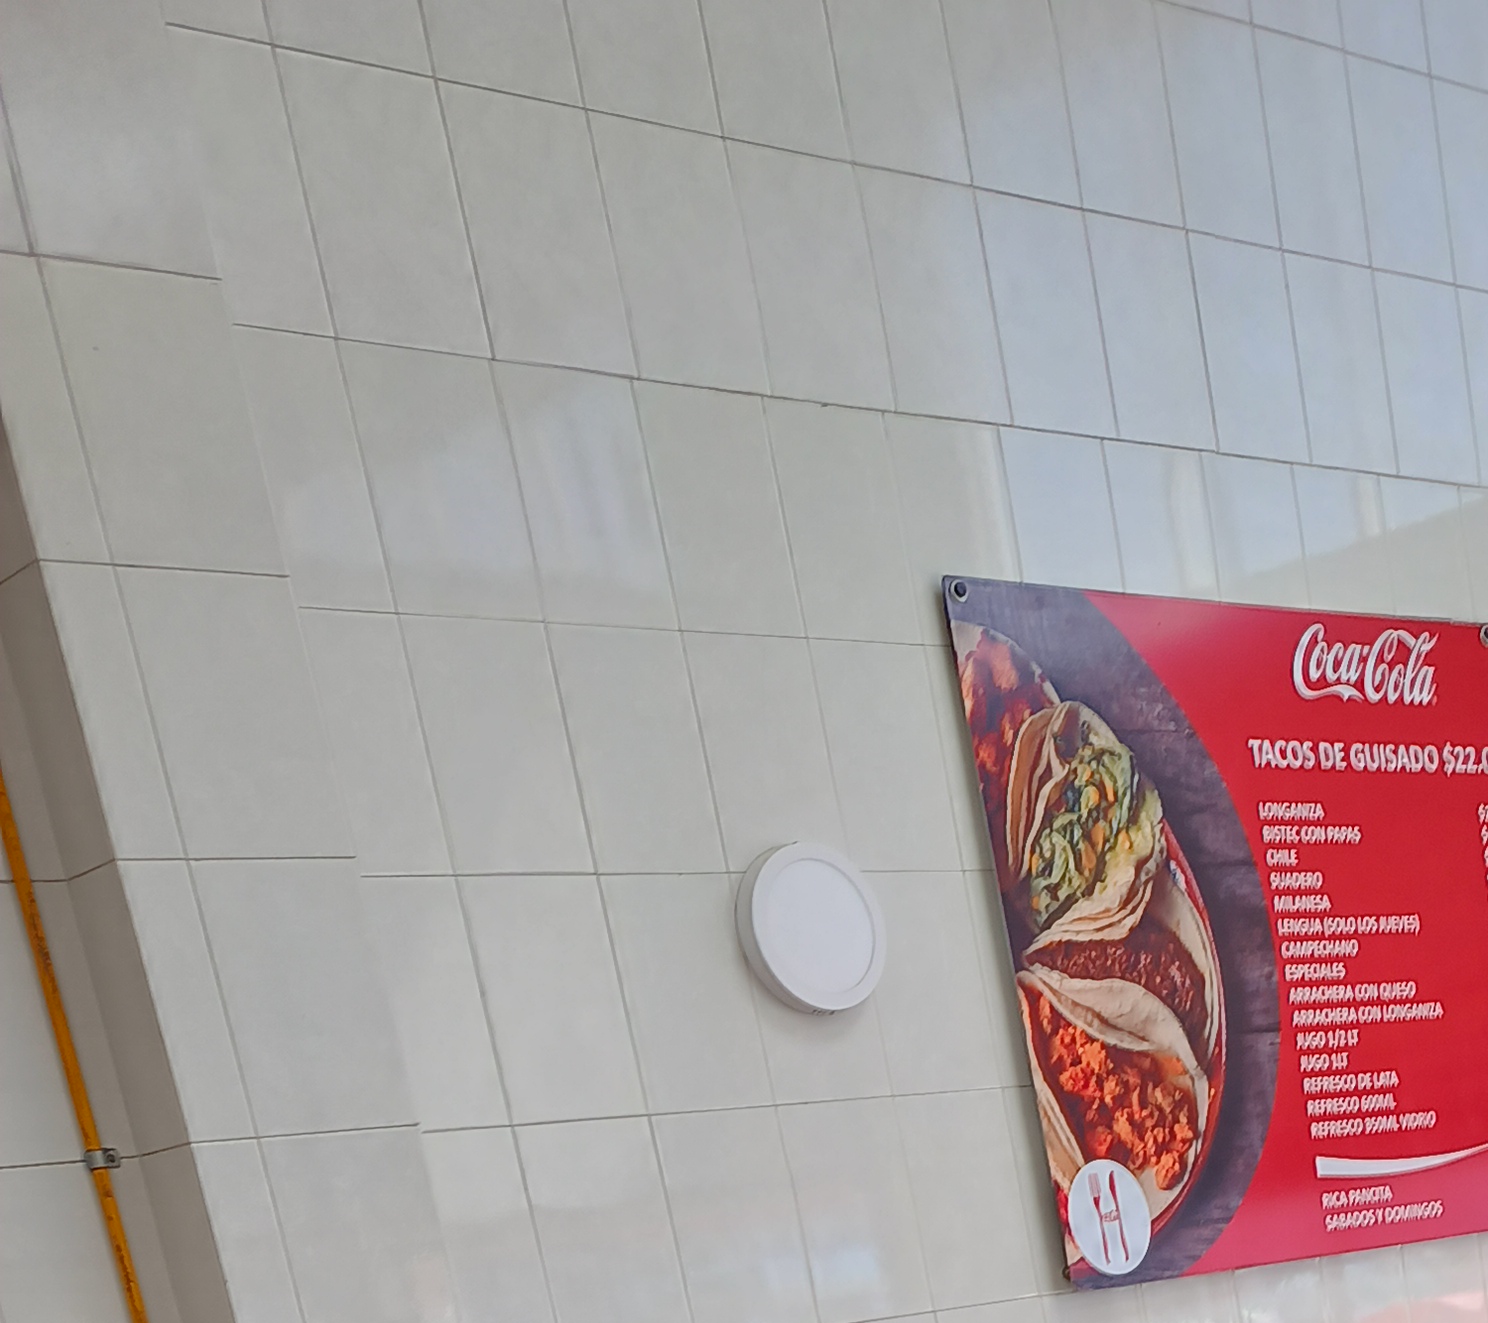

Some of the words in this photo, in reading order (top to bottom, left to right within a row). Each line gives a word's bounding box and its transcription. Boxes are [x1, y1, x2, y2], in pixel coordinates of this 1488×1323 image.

[1293, 622, 1438, 706] Coca-Cola
[1248, 739, 1315, 769] TACOS
[1319, 742, 1347, 771] DE
[1350, 743, 1439, 773] GUISADO
[1258, 802, 1325, 820] LONGANIZA
[1262, 825, 1300, 843] BISTEC
[1301, 826, 1326, 843] CON
[1327, 826, 1361, 844] PAPAS
[1266, 849, 1298, 866] CHILE
[1270, 872, 1323, 889] SUADERO
[1274, 895, 1331, 912] MILANESA
[1277, 918, 1323, 936] LENGUA
[1324, 916, 1356, 937] (SOLO
[1357, 916, 1378, 934] LOS
[1379, 914, 1420, 936] JUEVES)
[1281, 939, 1359, 958] CAMPECHANO
[1285, 962, 1346, 981] ESPECIALES
[1289, 984, 1354, 1005] ARRACHERA
[1355, 983, 1378, 1002] CON
[1380, 981, 1416, 1002] QUESO
[1292, 1007, 1357, 1028] ARRACHERA
[1358, 1005, 1382, 1024] CON
[1383, 1002, 1444, 1022] LONGANIZA
[1296, 1031, 1326, 1050] JUGO
[1327, 1029, 1346, 1050] 1/2
[1300, 1053, 1329, 1072] JUGO
[1303, 1074, 1356, 1094] REFRESCO
[1357, 1072, 1372, 1090] DE
[1373, 1070, 1399, 1089] LATA
[1307, 1096, 1360, 1117] REFRESCO
[1310, 1118, 1363, 1140] REFRESCO
[1399, 1110, 1437, 1131] VIDRIO
[1322, 1191, 1348, 1210] RICA
[1349, 1185, 1393, 1207] PANCITA
[1324, 1210, 1375, 1232] SABADOS
[1376, 1208, 1384, 1225] Y
[1385, 1200, 1444, 1224] DOMINGOS
